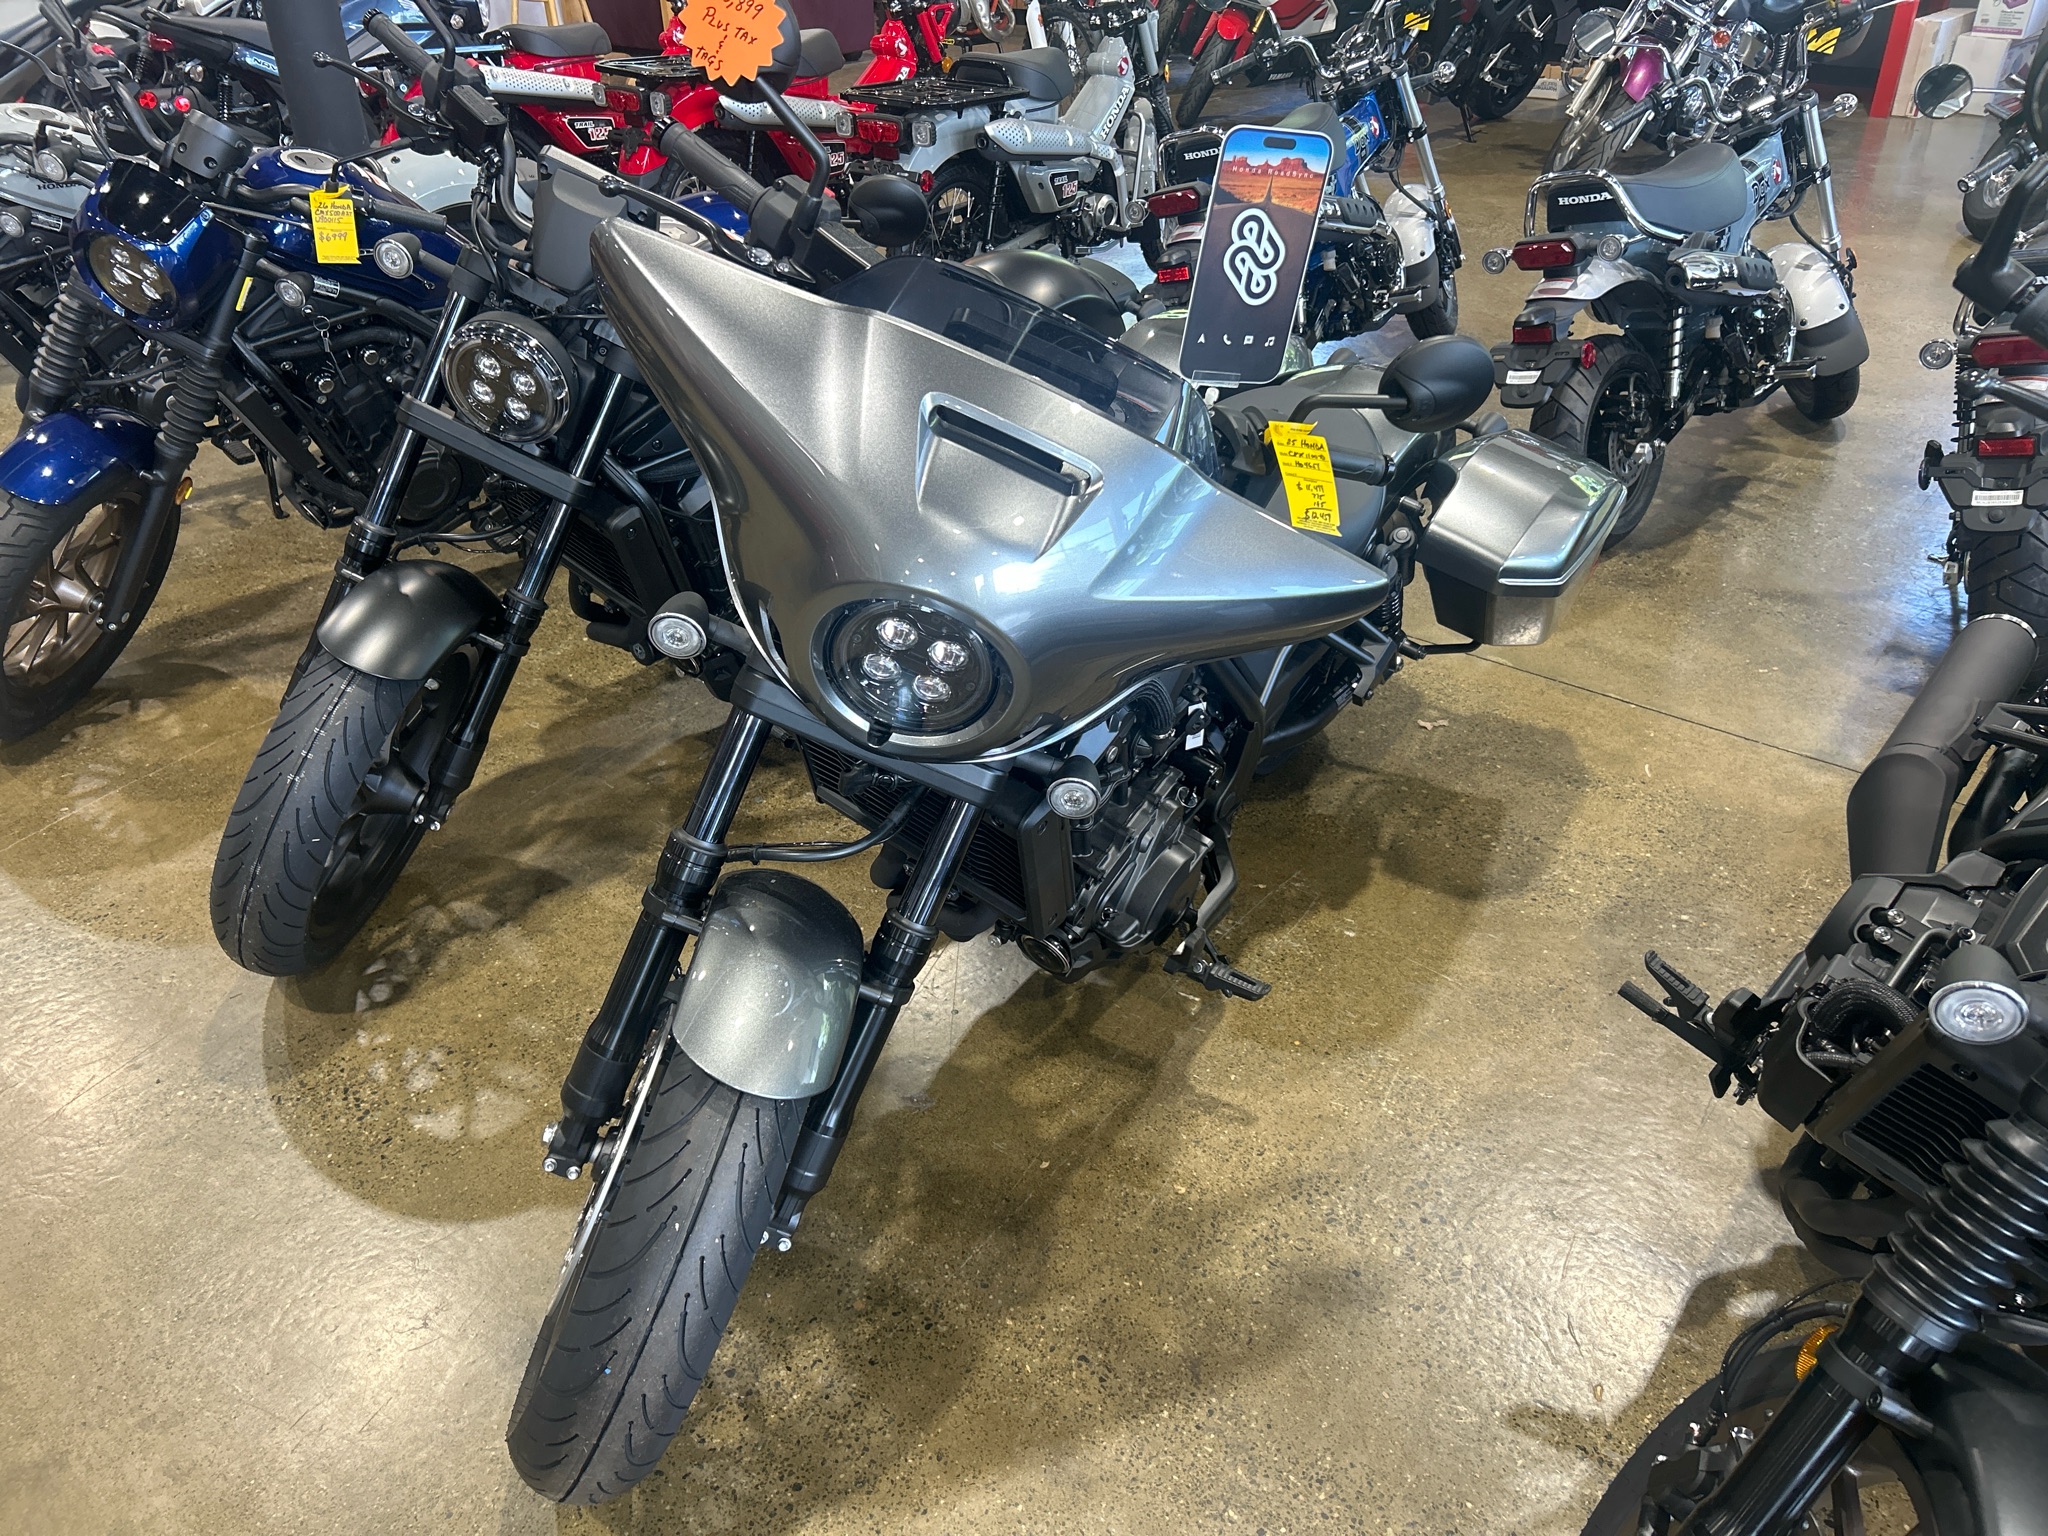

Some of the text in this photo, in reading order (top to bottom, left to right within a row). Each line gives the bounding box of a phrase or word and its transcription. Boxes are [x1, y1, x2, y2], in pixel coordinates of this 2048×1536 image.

[723, 0, 764, 20] ,899
[702, 6, 758, 45] PLUS TAX
[253, 56, 278, 71] NAV
[695, 46, 723, 71] TAGS
[1100, 86, 1130, 141] HONDA
[574, 121, 595, 129] TRAIL
[828, 151, 845, 167] 25
[1184, 146, 1222, 161] HOND
[1232, 165, 1314, 179] Honda RoadSync
[1062, 180, 1078, 198] 125
[1557, 191, 1614, 206] HONDA
